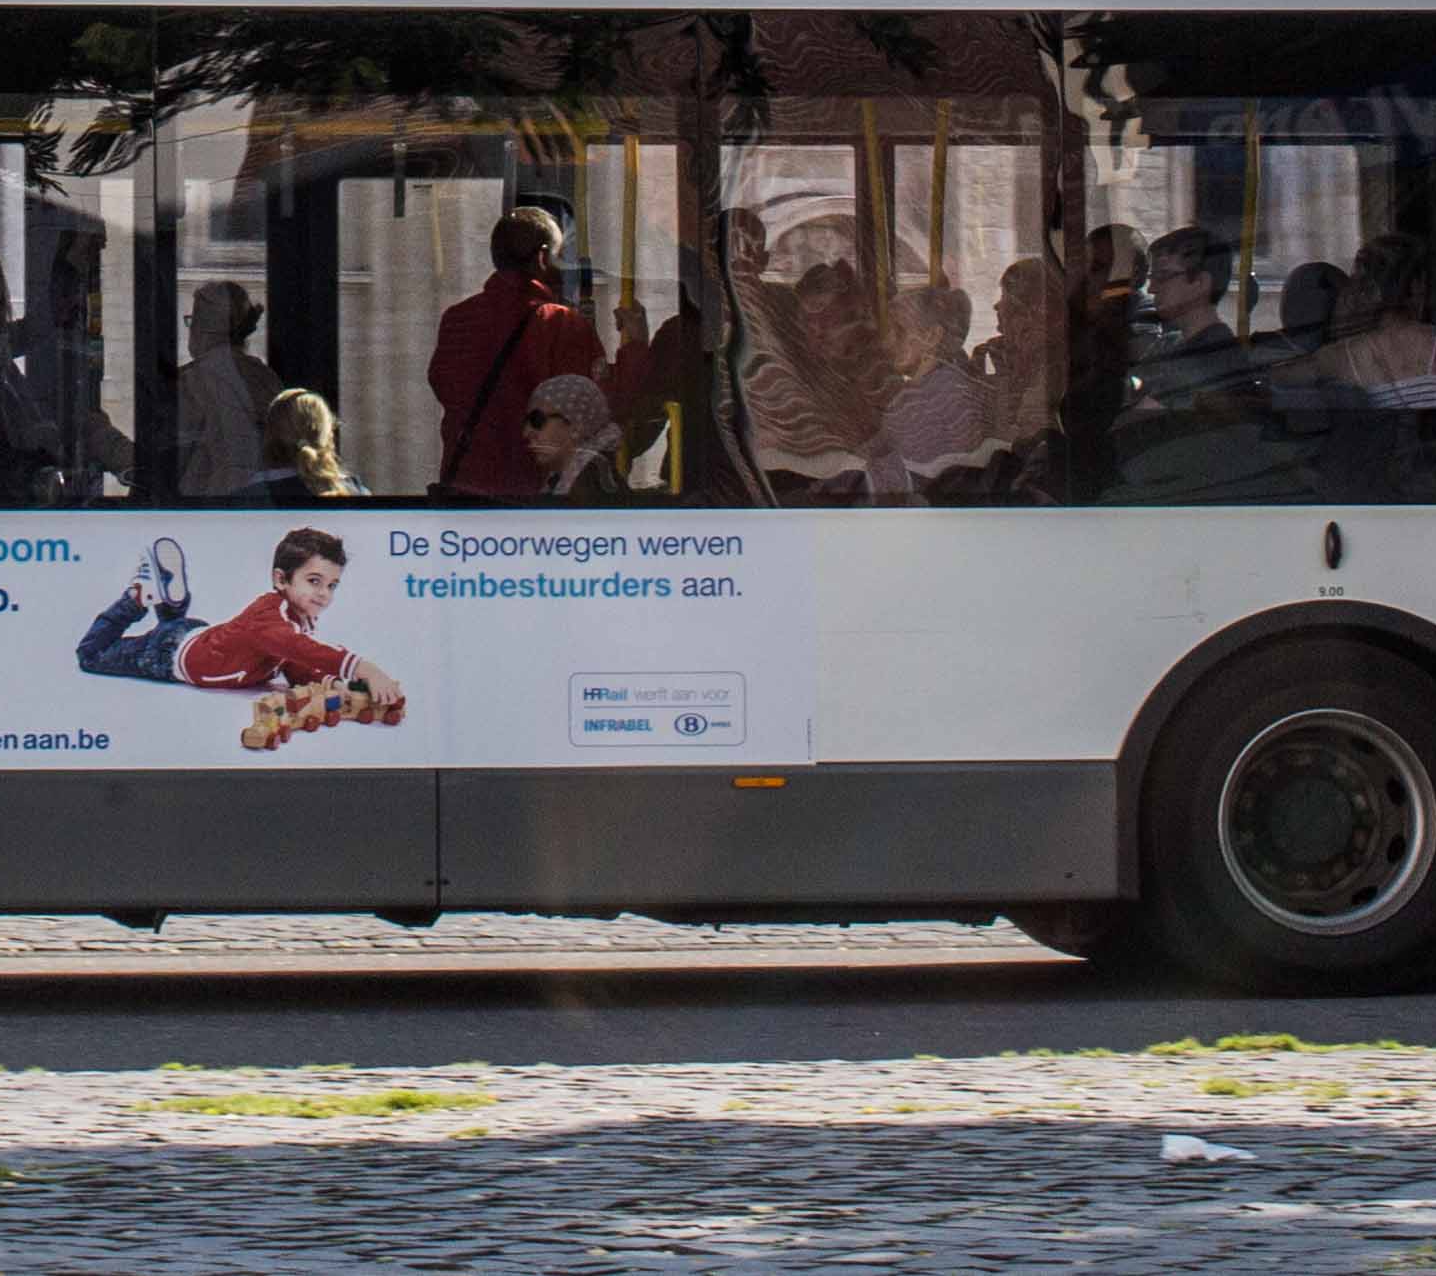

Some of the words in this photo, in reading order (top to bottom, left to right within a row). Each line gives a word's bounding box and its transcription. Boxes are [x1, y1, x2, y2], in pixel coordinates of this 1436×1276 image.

[389, 530, 429, 557] De
[439, 530, 628, 563] Spoorwegen
[636, 535, 743, 556] werven
[404, 571, 672, 598] treinbestuurders
[681, 576, 743, 597] aan.
[583, 718, 653, 732] INFRABEL
